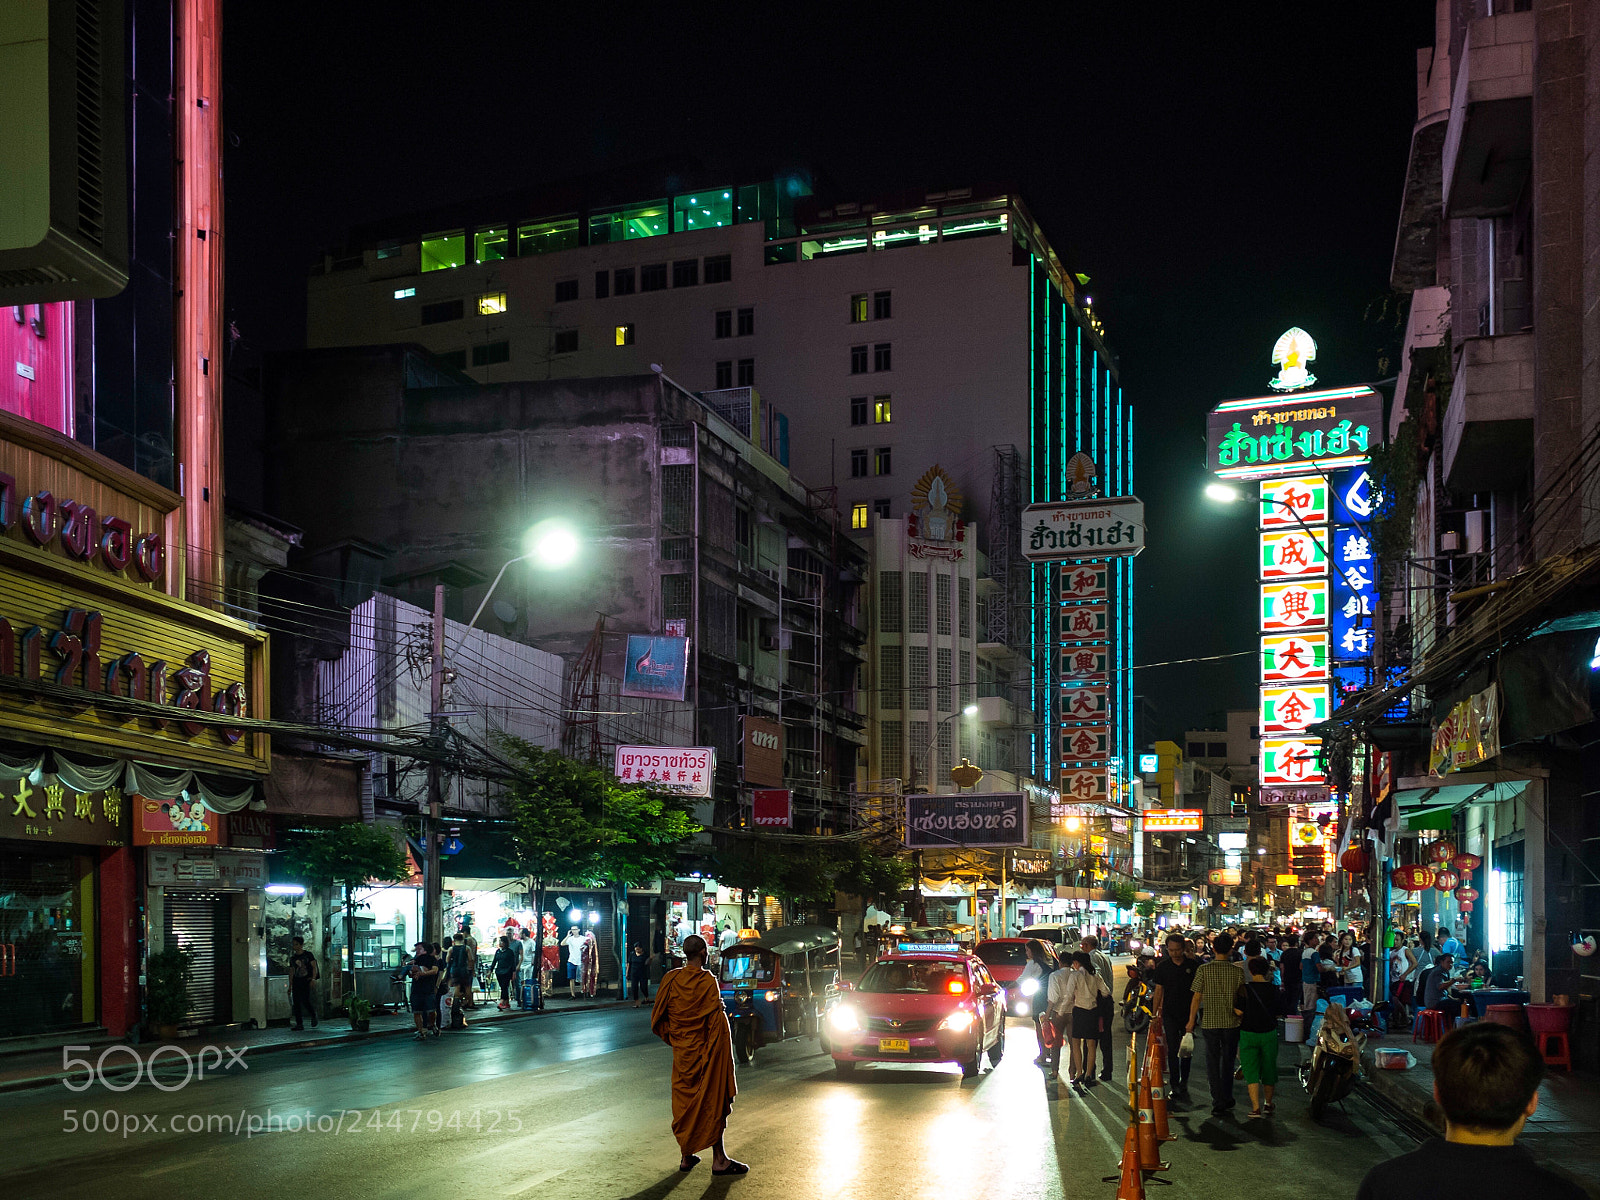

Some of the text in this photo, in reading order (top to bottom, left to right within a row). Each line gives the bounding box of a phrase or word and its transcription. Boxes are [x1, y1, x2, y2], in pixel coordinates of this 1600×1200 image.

[1252, 406, 1337, 427] ห้างขายทอง
[1218, 419, 1372, 466] ฮั่วเซ่งเฮง
[1052, 507, 1112, 523] ห้างขายทอง
[1029, 518, 1137, 550] ฮั่วเซ่งเฮง
[621, 752, 708, 769] เยาวราชทัวร์
[230, 815, 272, 836] KUANG
